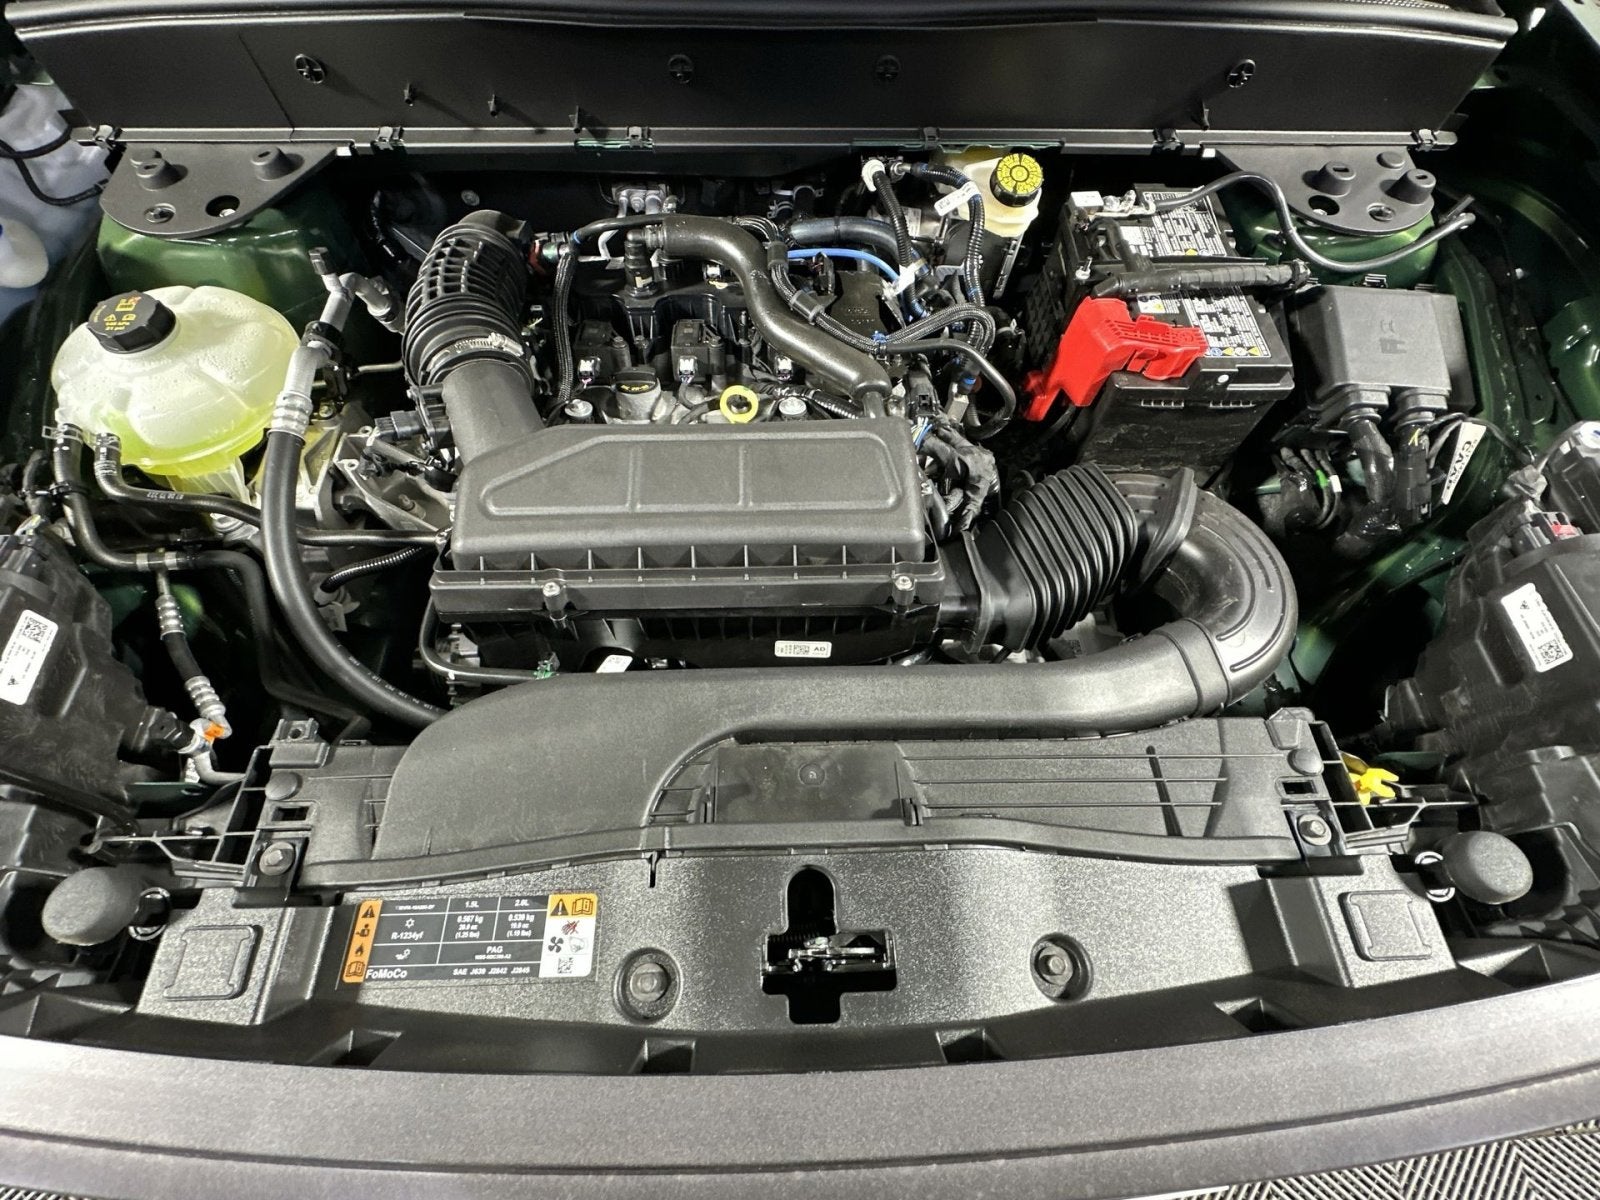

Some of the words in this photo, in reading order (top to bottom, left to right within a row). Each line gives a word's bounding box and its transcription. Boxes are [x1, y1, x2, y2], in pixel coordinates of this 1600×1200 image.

[474, 915, 484, 924] kg
[525, 913, 535, 922] kg
[391, 931, 424, 941] R-1234yf
[486, 945, 503, 954] PAG
[365, 968, 408, 979] FoMoCo
[452, 968, 468, 976] SAE
